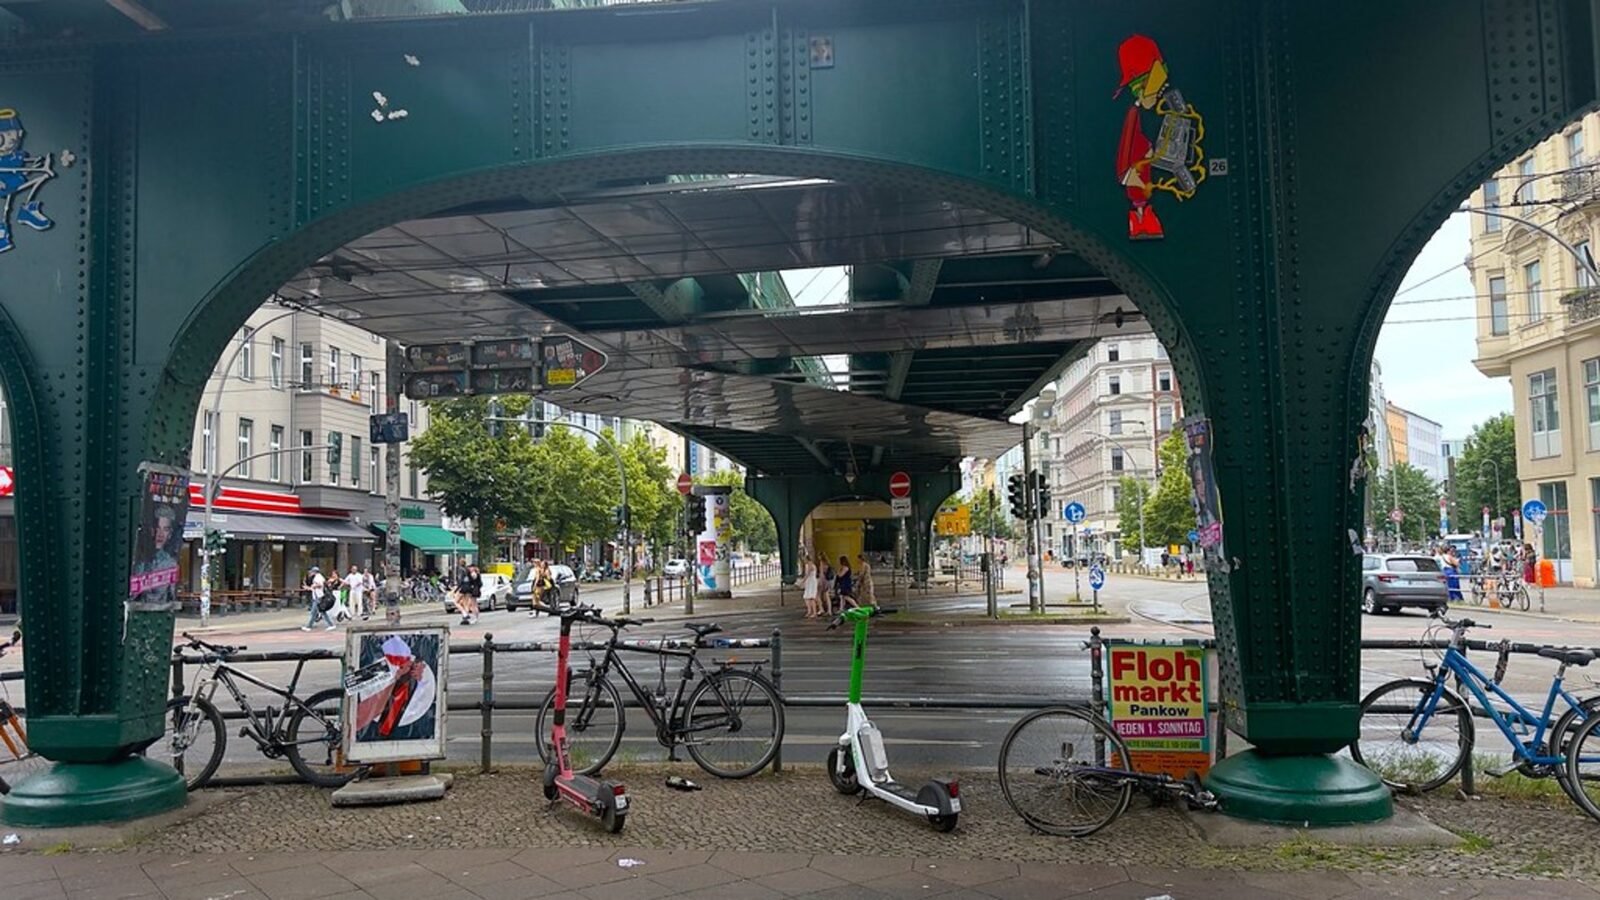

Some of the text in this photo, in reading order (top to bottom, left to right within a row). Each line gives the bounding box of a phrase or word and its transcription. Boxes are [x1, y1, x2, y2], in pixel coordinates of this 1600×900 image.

[1212, 161, 1225, 172] 26
[1112, 651, 1200, 681] Floh
[1114, 682, 1202, 702] markt
[1130, 704, 1189, 716] Pankow
[1148, 722, 1157, 734] 1.
[1158, 722, 1201, 734] SONNTAG
